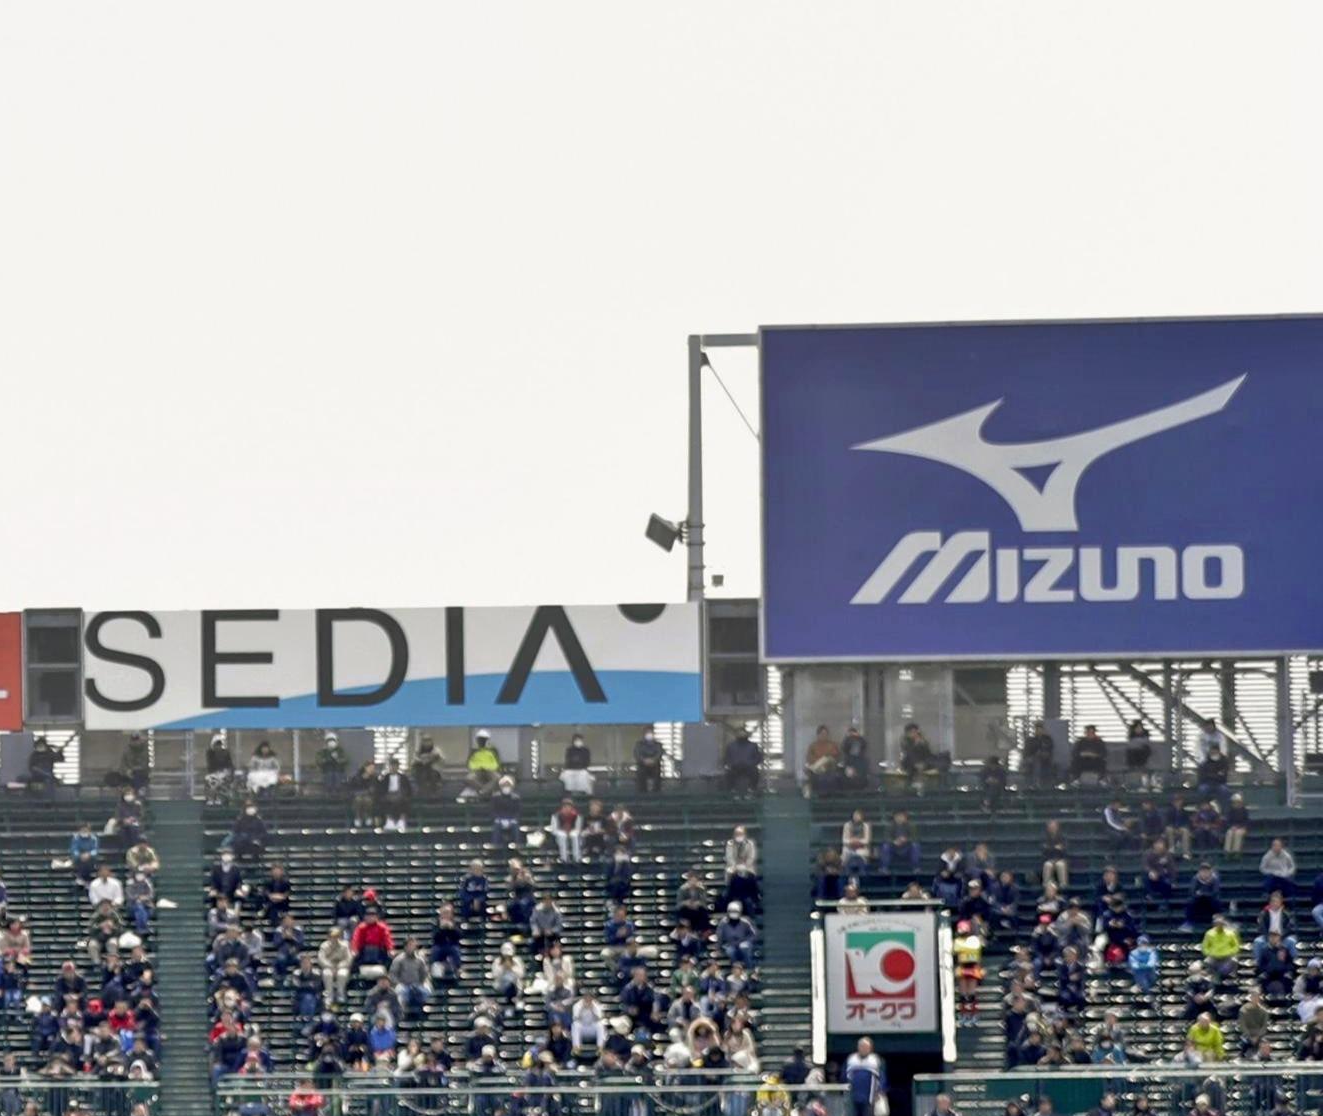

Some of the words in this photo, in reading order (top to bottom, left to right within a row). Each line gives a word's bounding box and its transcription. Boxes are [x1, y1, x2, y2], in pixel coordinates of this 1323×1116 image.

[849, 529, 1246, 605] MIZUNO
[84, 606, 608, 713] SEDIA
[845, 1002, 917, 1020] オークワ
